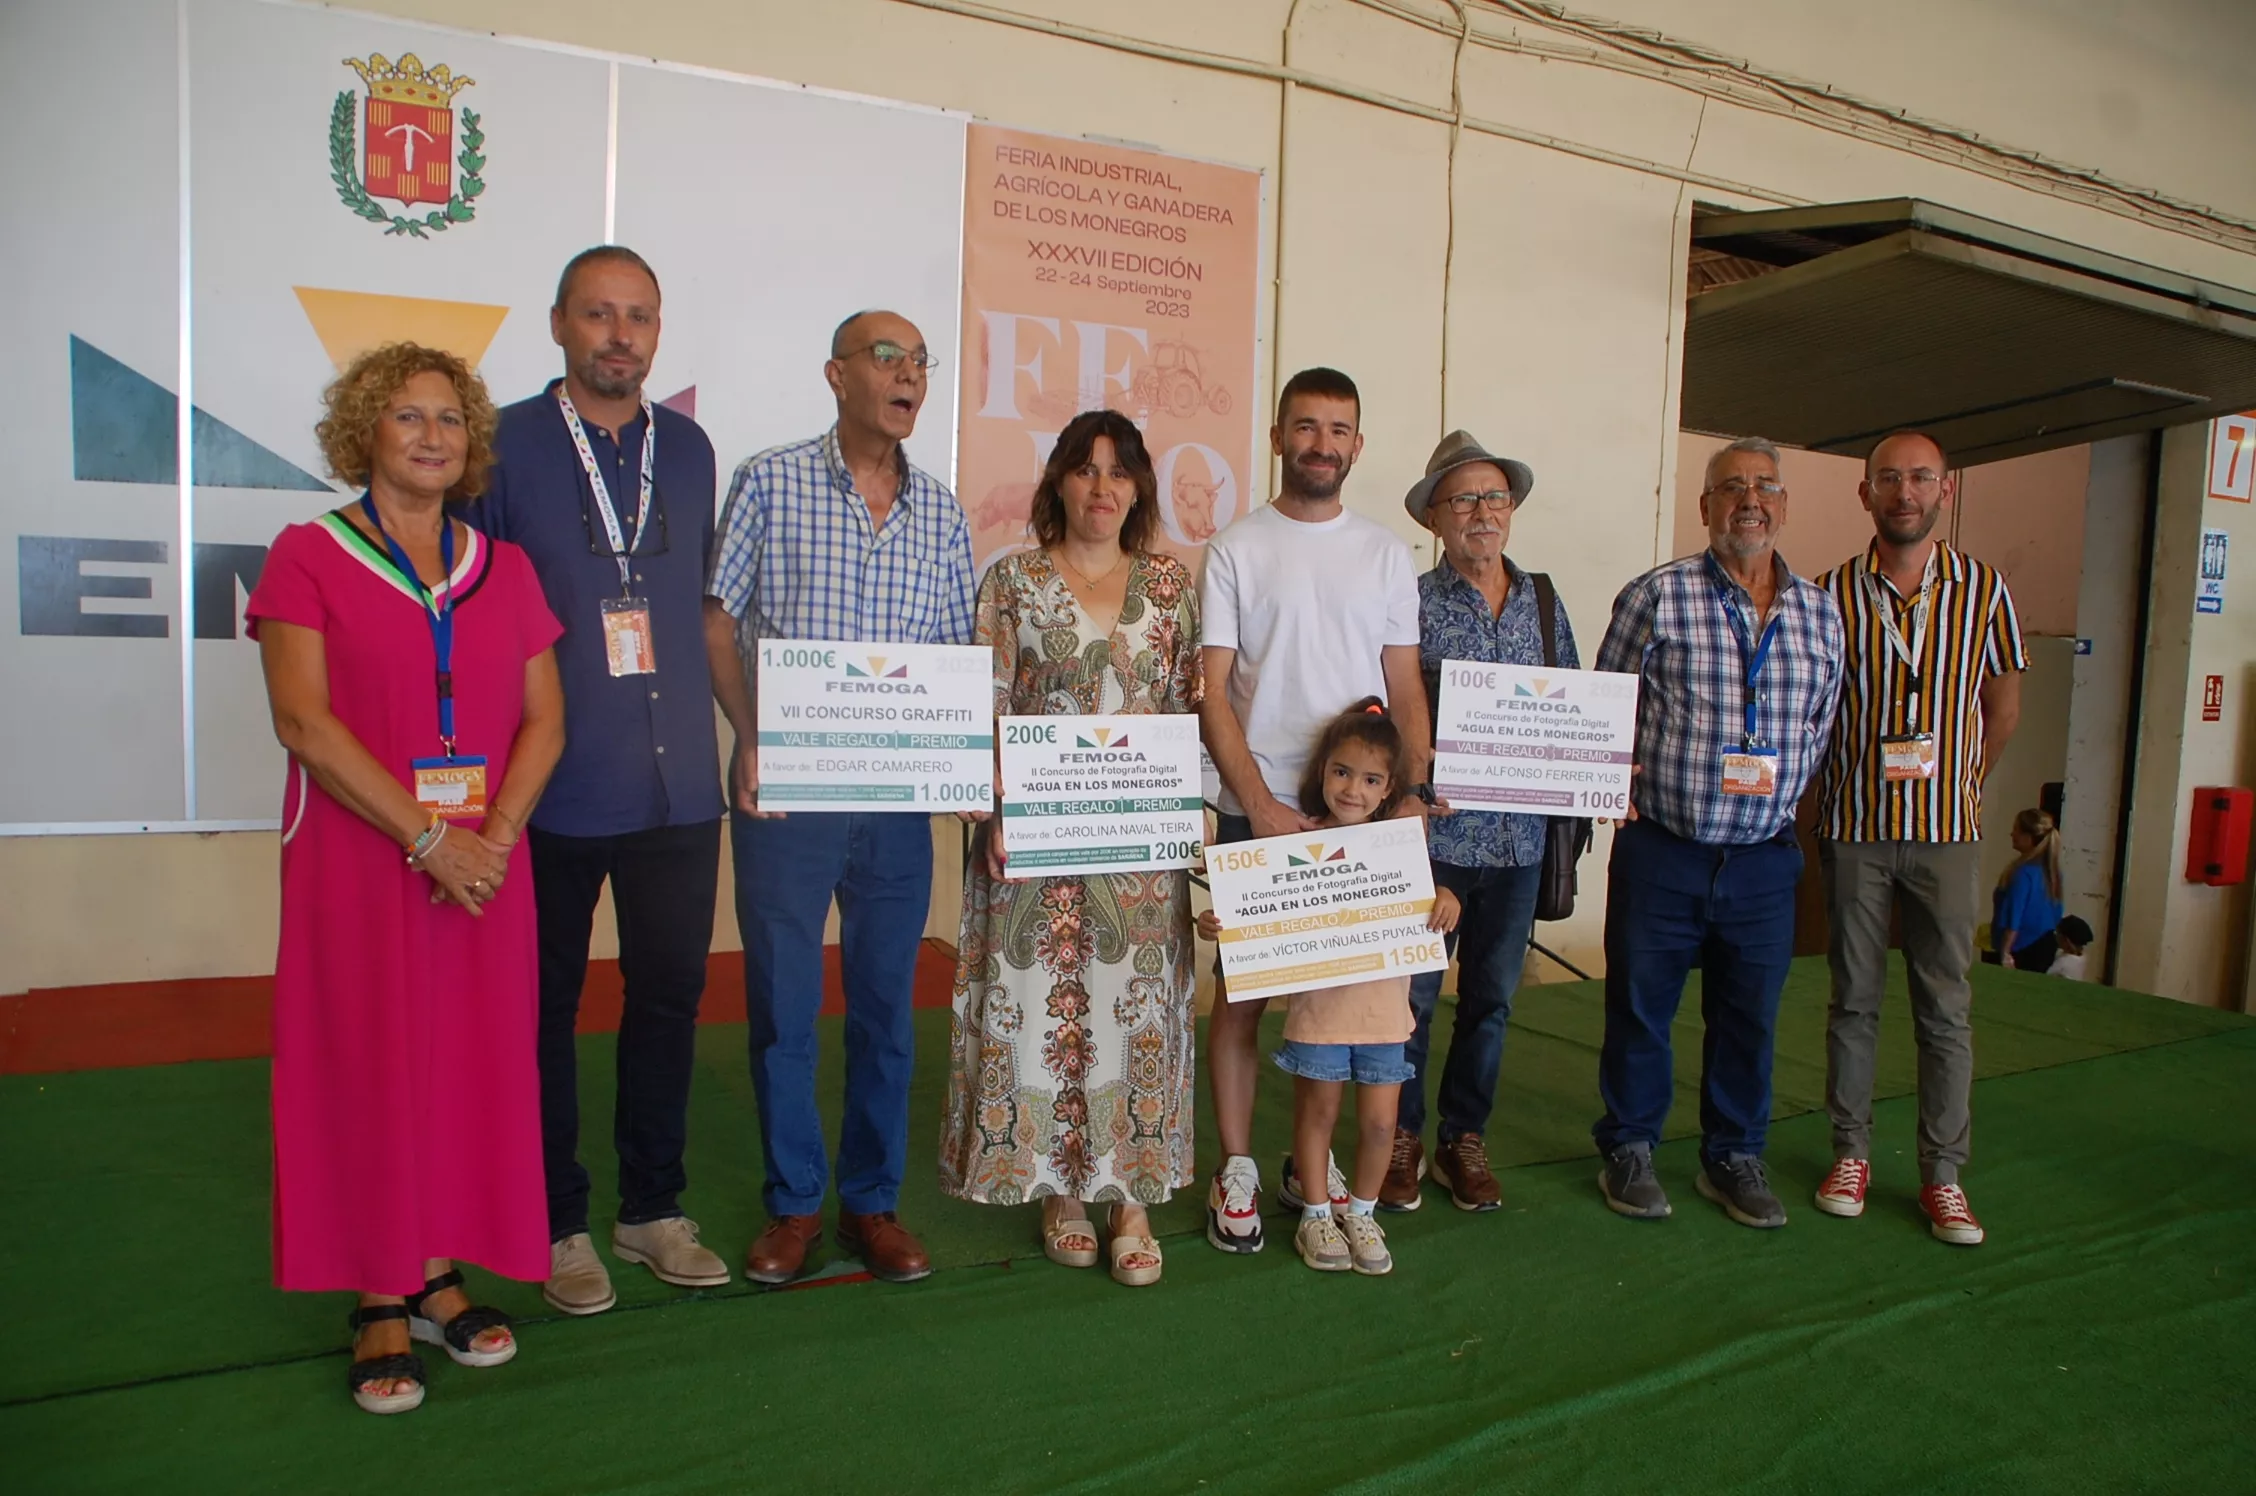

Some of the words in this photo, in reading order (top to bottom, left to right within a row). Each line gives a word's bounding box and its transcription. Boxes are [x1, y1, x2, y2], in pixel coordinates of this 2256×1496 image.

[996, 145, 1056, 171] FERIA
[1060, 156, 1182, 192] INDUSTRIAL,
[994, 173, 1103, 205] AGRÍCOLA
[1106, 189, 1120, 207] Y
[1124, 192, 1234, 225] GANADERA
[993, 200, 1022, 219] DE
[1026, 204, 1067, 227] LOS
[1071, 211, 1188, 243] MONEGROS
[1026, 239, 1107, 269] XXXVII
[1112, 251, 1203, 282] EDICIÓN
[1097, 275, 1192, 301] Septiembre
[1145, 299, 1190, 319] 2023
[2226, 424, 2247, 489] 7
[2205, 582, 2219, 594] WC
[762, 648, 837, 669] 1.000€
[825, 681, 929, 695] FEMOGA
[1448, 669, 1497, 690] 100€
[780, 705, 801, 719] VII
[805, 706, 898, 721] CONCURSO
[901, 708, 973, 722] GRAFFITI
[1495, 700, 1582, 714] FEMOGA
[1465, 711, 1472, 719] II
[1474, 711, 1518, 722] Concurso
[1520, 714, 1531, 723] de
[1581, 718, 1610, 729] Digital
[782, 733, 820, 747] VALE
[826, 733, 888, 748] REGALO
[910, 735, 968, 748] PREMIO
[1006, 724, 1057, 745] 200€
[1498, 727, 1514, 736] EN
[1517, 728, 1540, 738] LOS
[1059, 752, 1148, 764] FEMOGA
[1456, 741, 1488, 754] VALE
[1492, 743, 1545, 757] REGALO
[1563, 748, 1612, 762] PREMIO
[763, 761, 771, 771] A
[771, 761, 796, 772] favor
[816, 760, 867, 772] EDGAR
[871, 760, 953, 773] CAMARERO
[1031, 768, 1037, 776] II
[1040, 766, 1085, 777] Concurso
[1088, 766, 1099, 776] de
[1149, 764, 1178, 776] Digital
[1440, 765, 1447, 773] A
[1448, 765, 1469, 775] favor
[1484, 765, 1542, 780] ALFONSO
[1545, 769, 1594, 783] FERRER
[1596, 771, 1621, 784] YUS
[920, 783, 991, 802] 1.000€
[1065, 781, 1081, 791] EN
[1085, 780, 1109, 790] LOS
[1024, 802, 1057, 815] VALE
[1062, 800, 1115, 814] REGALO
[1133, 798, 1182, 811] PREMIO
[1579, 790, 1626, 810] 100€
[1008, 832, 1016, 840] A
[1016, 831, 1037, 840] favor
[1054, 824, 1117, 839] CAROLINA
[1120, 823, 1157, 836] NAVAL
[1160, 821, 1194, 833] TEIRA
[1155, 840, 1202, 860] 200€
[1213, 848, 1268, 873] 150€
[1272, 861, 1368, 884] FEMOGA
[1242, 893, 1248, 901] II
[1251, 887, 1300, 900] Concurso
[1302, 883, 1315, 893] de
[1371, 870, 1402, 883] Digital
[1282, 900, 1299, 911] EN
[1303, 895, 1328, 907] LOS
[1240, 923, 1275, 938] VALE
[1280, 914, 1338, 933] REGALO
[1360, 902, 1414, 920] PREMIO
[1228, 955, 1236, 964] A
[1236, 953, 1256, 964] favor
[1272, 940, 1318, 957] VÍCTOR
[1321, 928, 1380, 950] VIÑUALES
[1390, 941, 1442, 966] 150€
